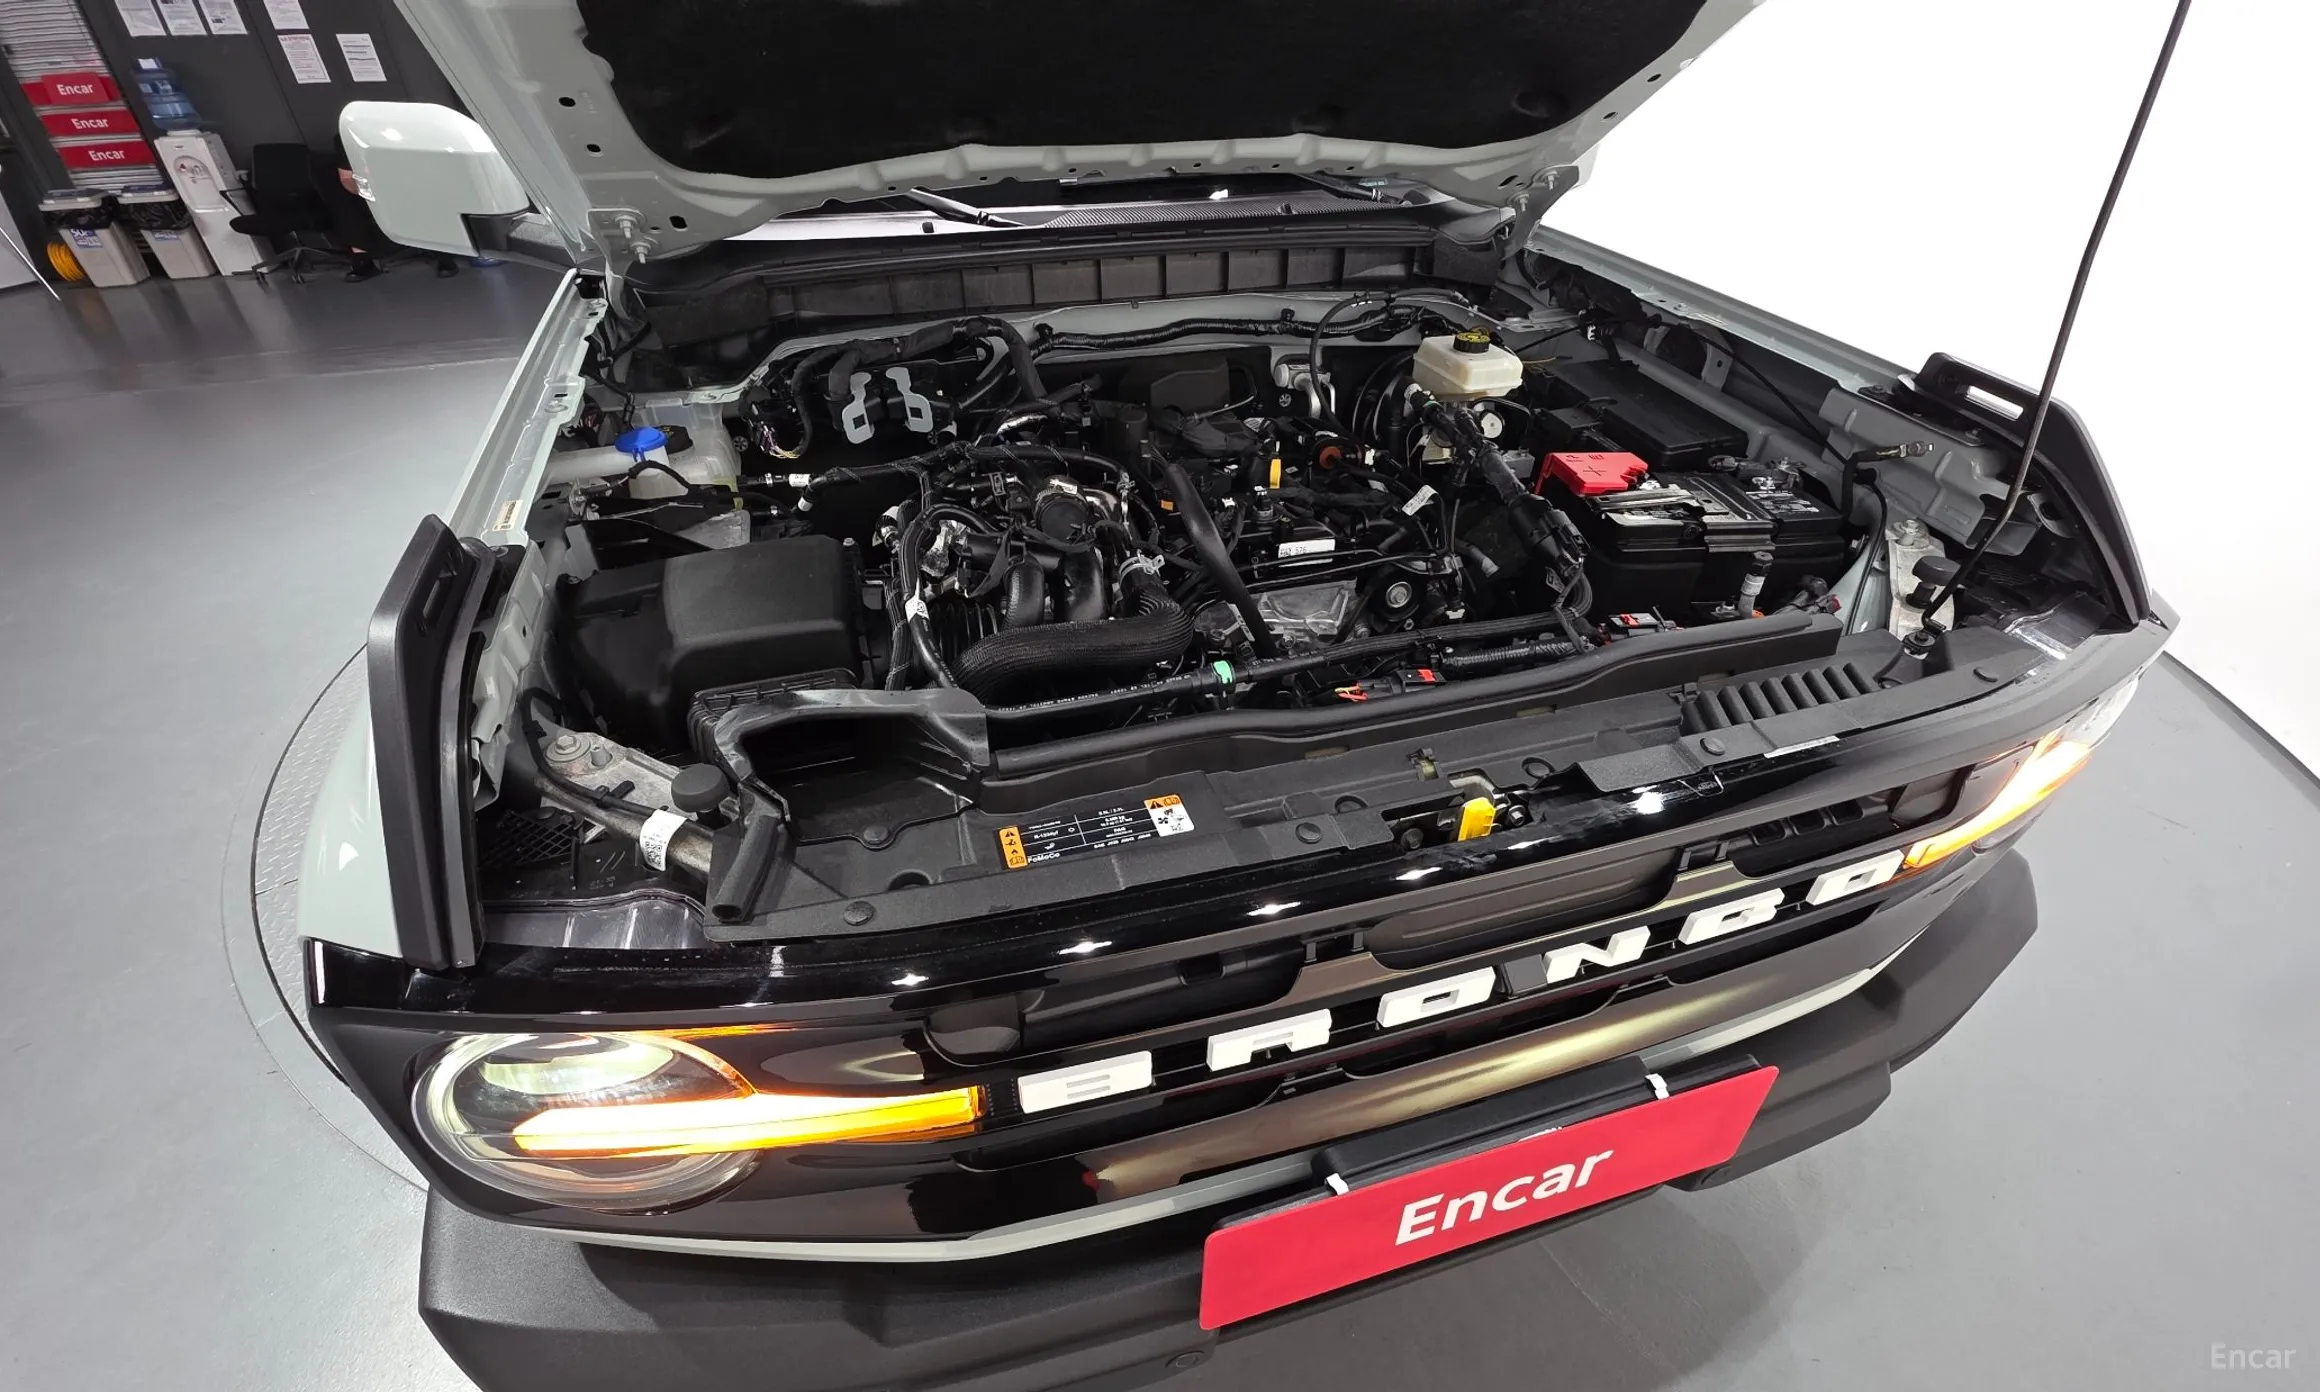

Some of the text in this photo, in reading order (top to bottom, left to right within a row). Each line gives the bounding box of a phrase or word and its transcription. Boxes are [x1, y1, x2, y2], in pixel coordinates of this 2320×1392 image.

[56, 84, 94, 95] Encar
[71, 118, 109, 129] Encar
[88, 150, 125, 161] Encar
[1027, 852, 1060, 863] FoMoCo
[1016, 849, 1905, 1114] BRONCO
[1395, 1149, 1614, 1246] Encar
